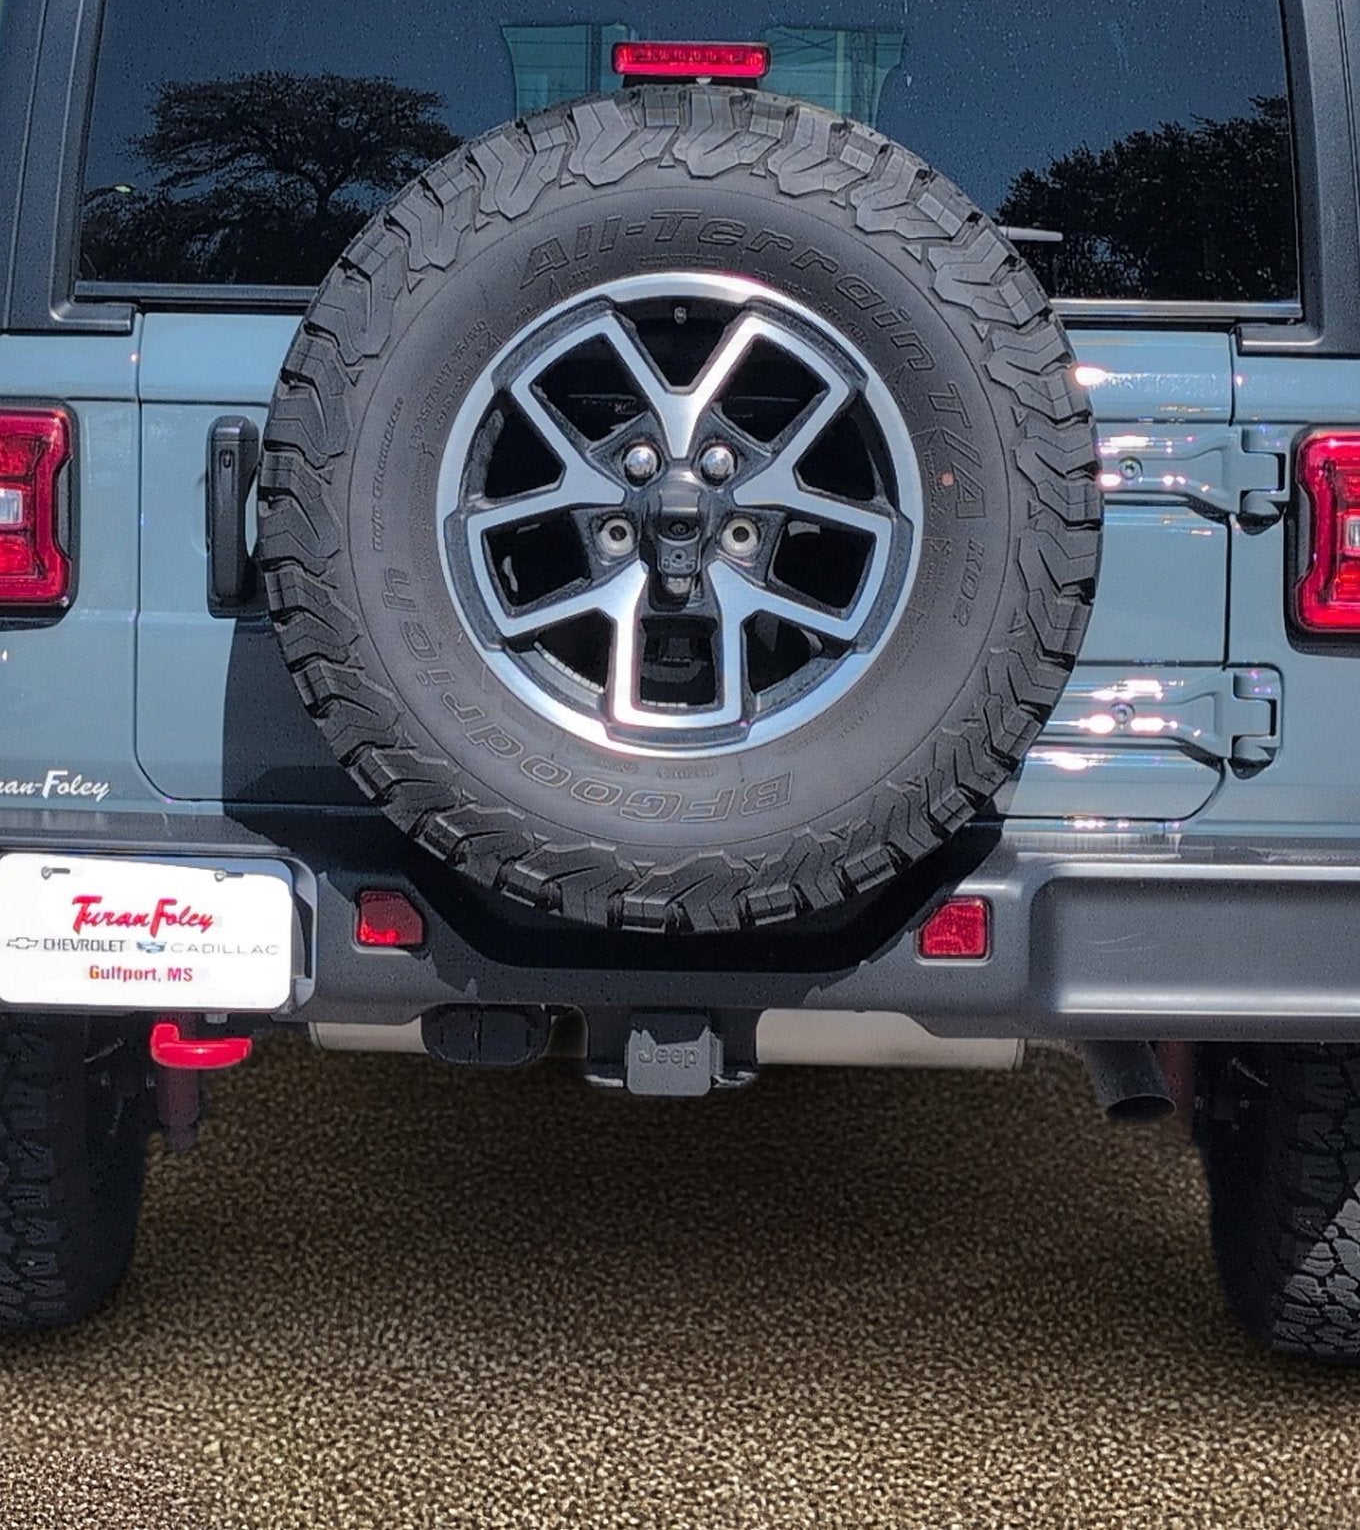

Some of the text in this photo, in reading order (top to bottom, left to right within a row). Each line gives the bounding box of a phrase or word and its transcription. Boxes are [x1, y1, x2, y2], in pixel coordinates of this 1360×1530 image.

[520, 209, 936, 372] All-Terrain
[928, 381, 986, 520] T/A
[383, 567, 794, 824] BFGoodrich
[42, 938, 281, 957] CHEVROLET CADILLAC
[88, 964, 195, 983] Gulfport, MS
[637, 1043, 700, 1069] Jeep
